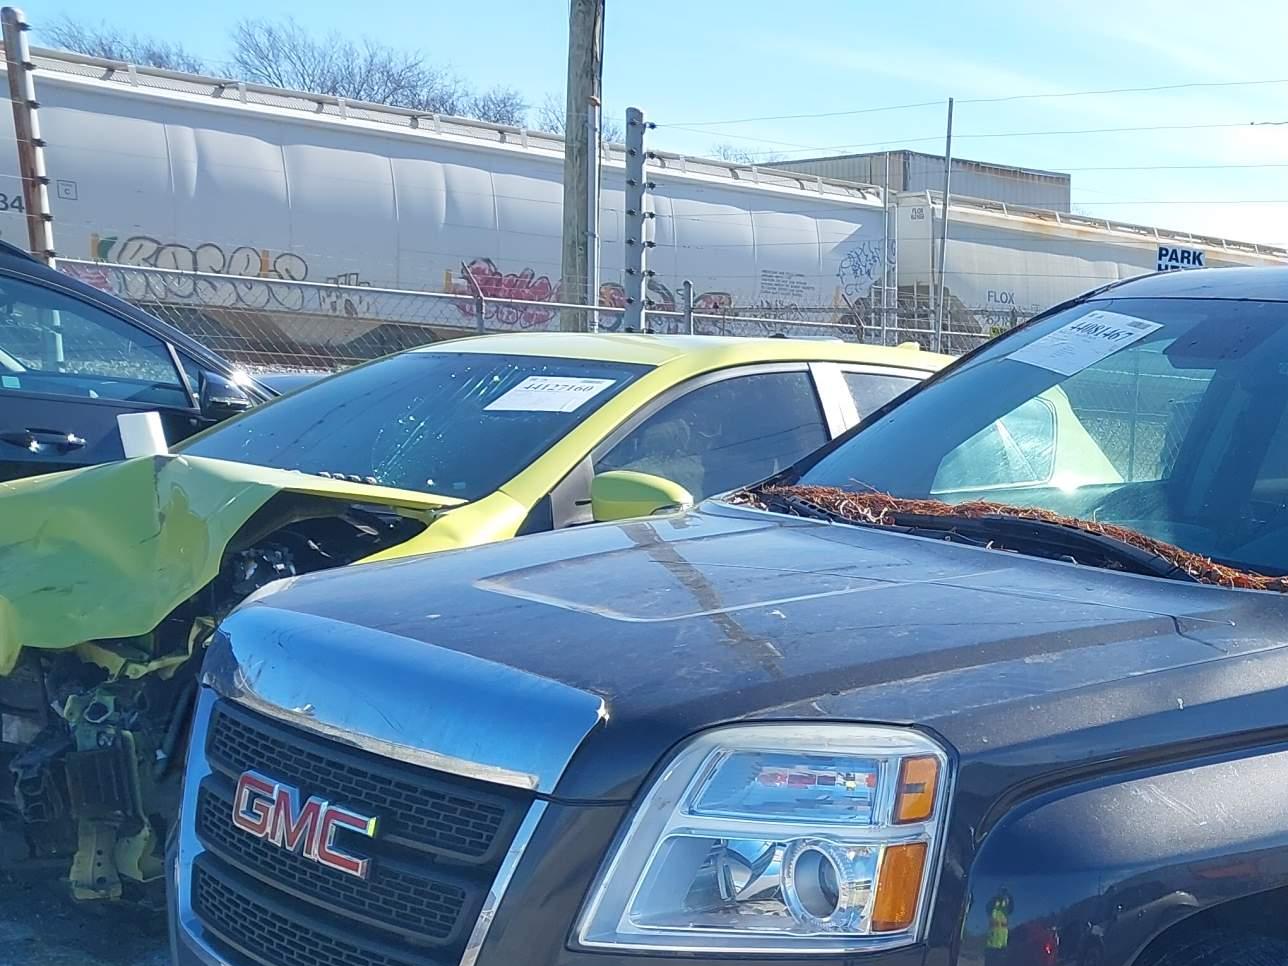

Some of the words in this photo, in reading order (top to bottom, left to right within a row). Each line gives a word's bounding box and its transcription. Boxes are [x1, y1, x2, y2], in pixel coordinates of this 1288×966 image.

[1158, 246, 1204, 267] PARK
[987, 290, 1015, 305] FLOX
[1070, 321, 1134, 343] 44081467
[524, 383, 595, 393] 44127160
[232, 770, 379, 880] GMC
